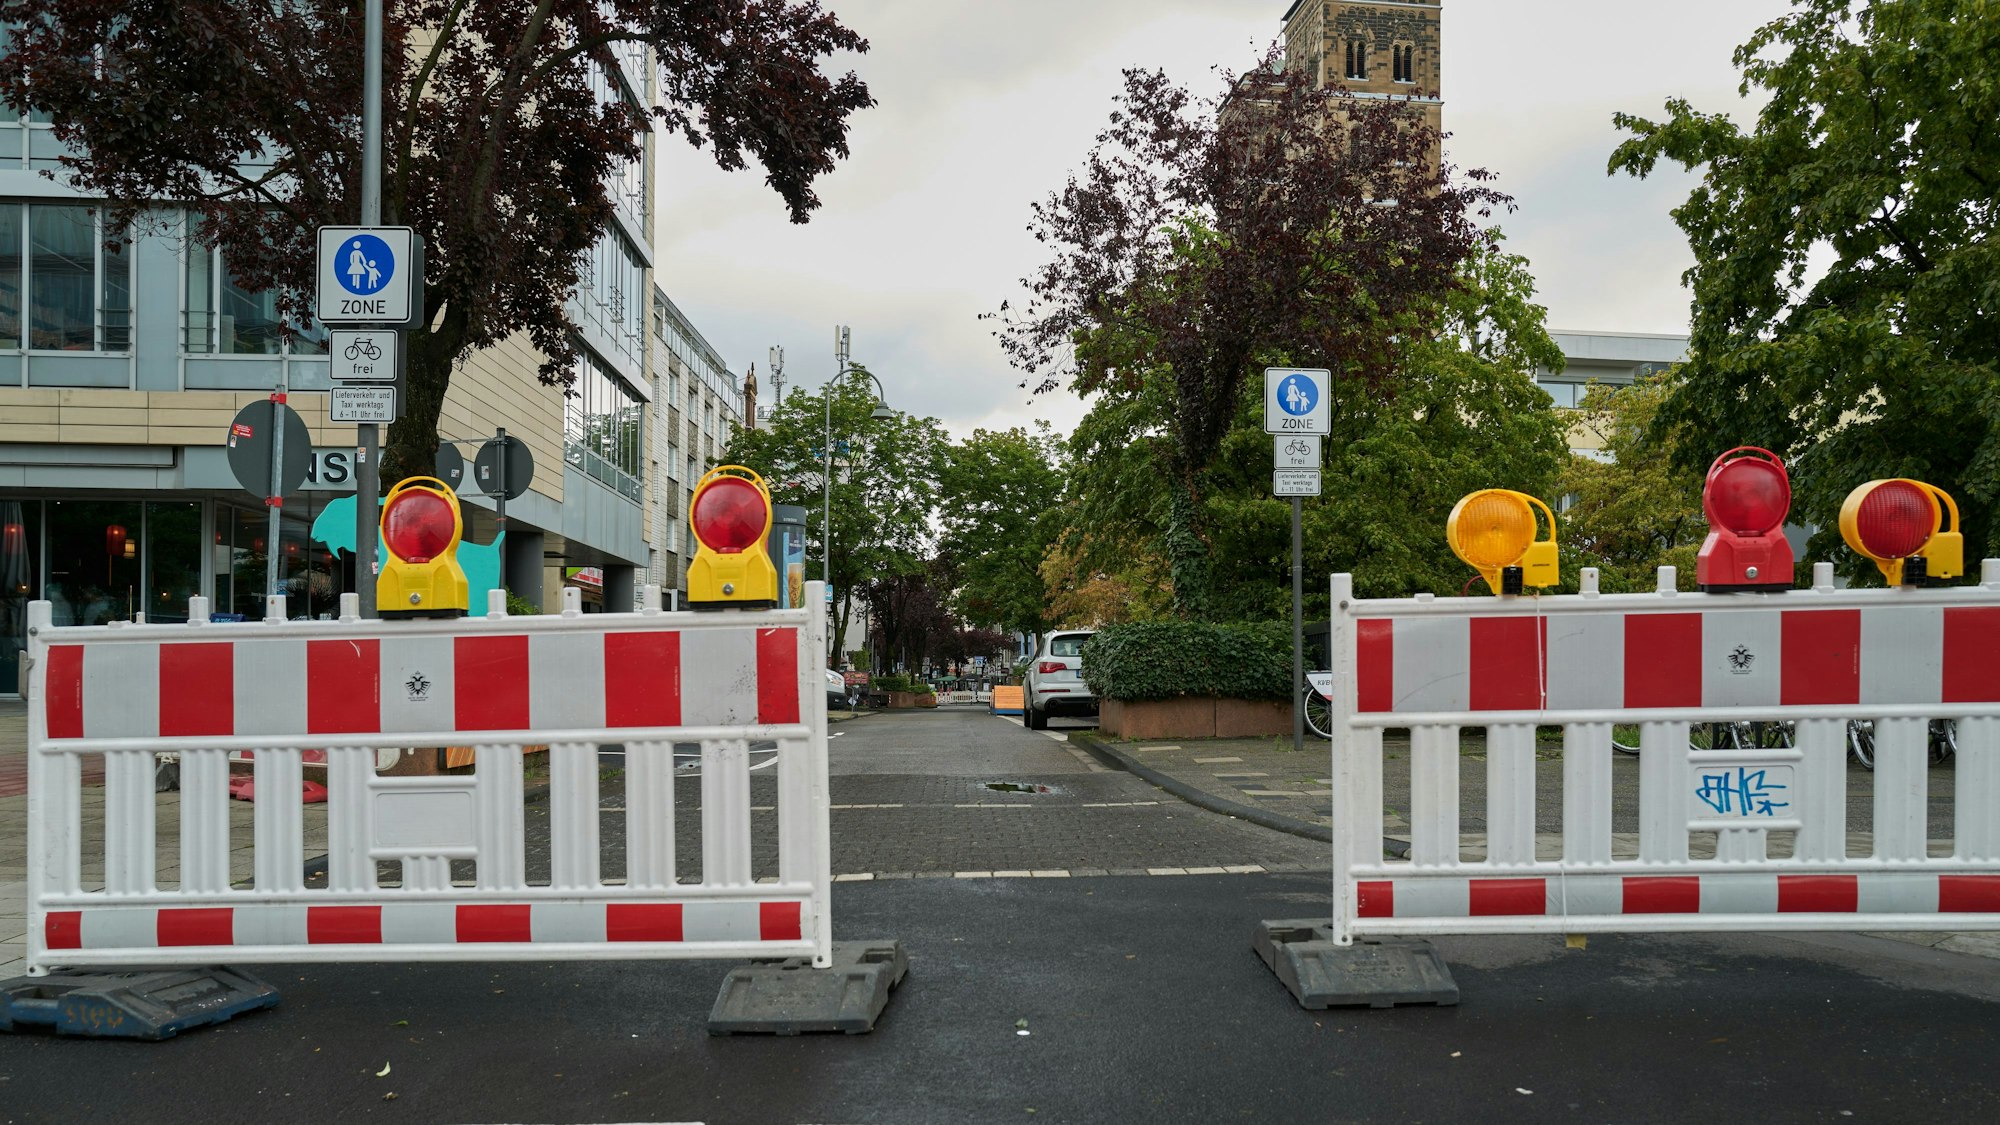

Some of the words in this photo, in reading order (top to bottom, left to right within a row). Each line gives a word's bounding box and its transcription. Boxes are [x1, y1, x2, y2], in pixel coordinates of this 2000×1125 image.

[341, 300, 386, 314] ZONE
[353, 363, 373, 374] frei
[335, 391, 376, 399] Lieferverkehr
[379, 391, 391, 399] und
[356, 401, 384, 410] werktags
[1282, 419, 1314, 429] ZONE
[1290, 457, 1305, 465] frei
